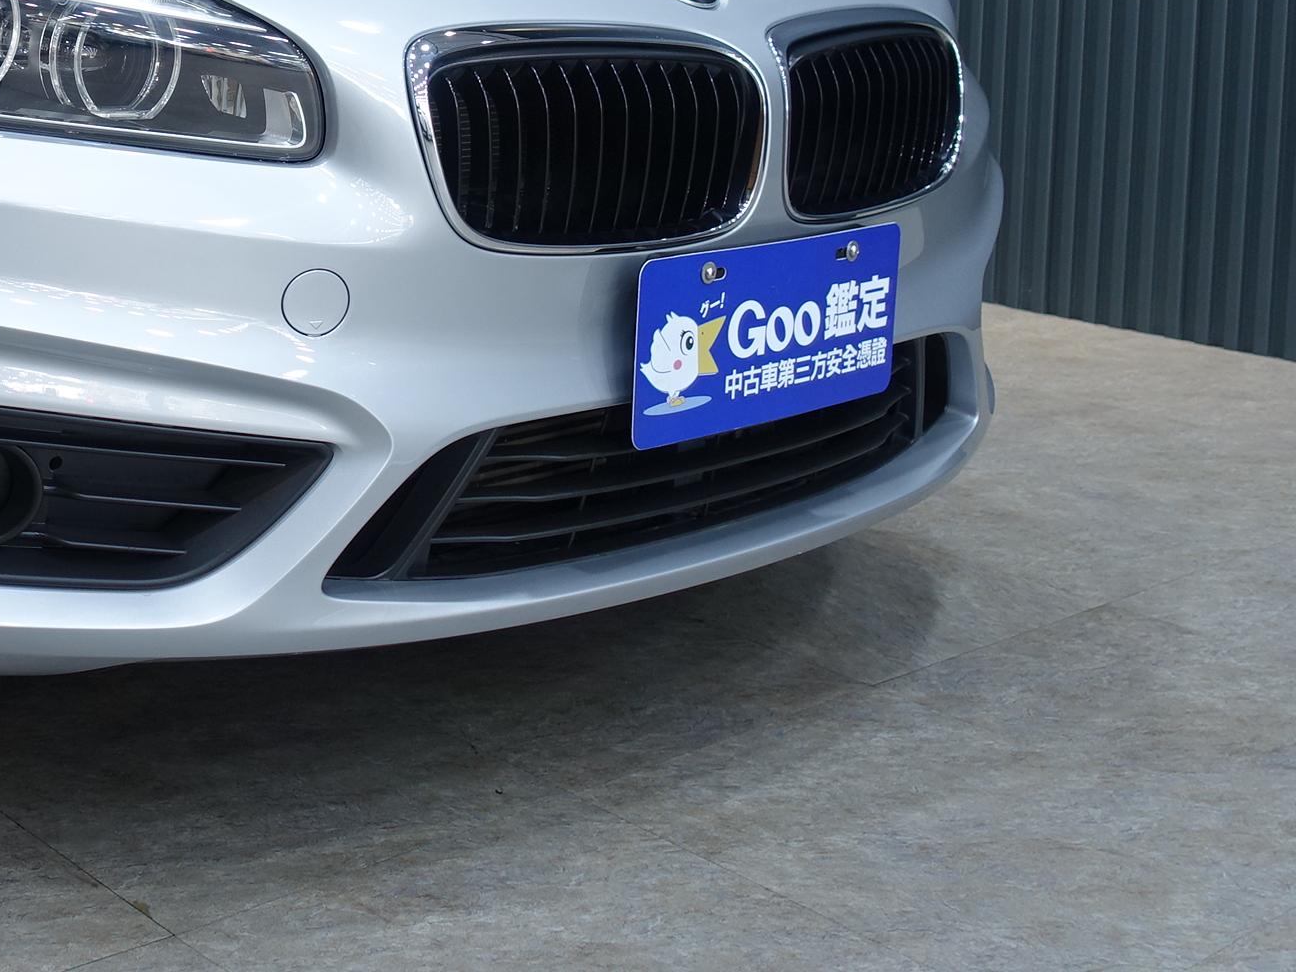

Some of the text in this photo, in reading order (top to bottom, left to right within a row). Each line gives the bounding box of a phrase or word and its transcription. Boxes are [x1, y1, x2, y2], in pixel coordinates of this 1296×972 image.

[725, 336, 888, 400] 中古車第三方安全憑證
